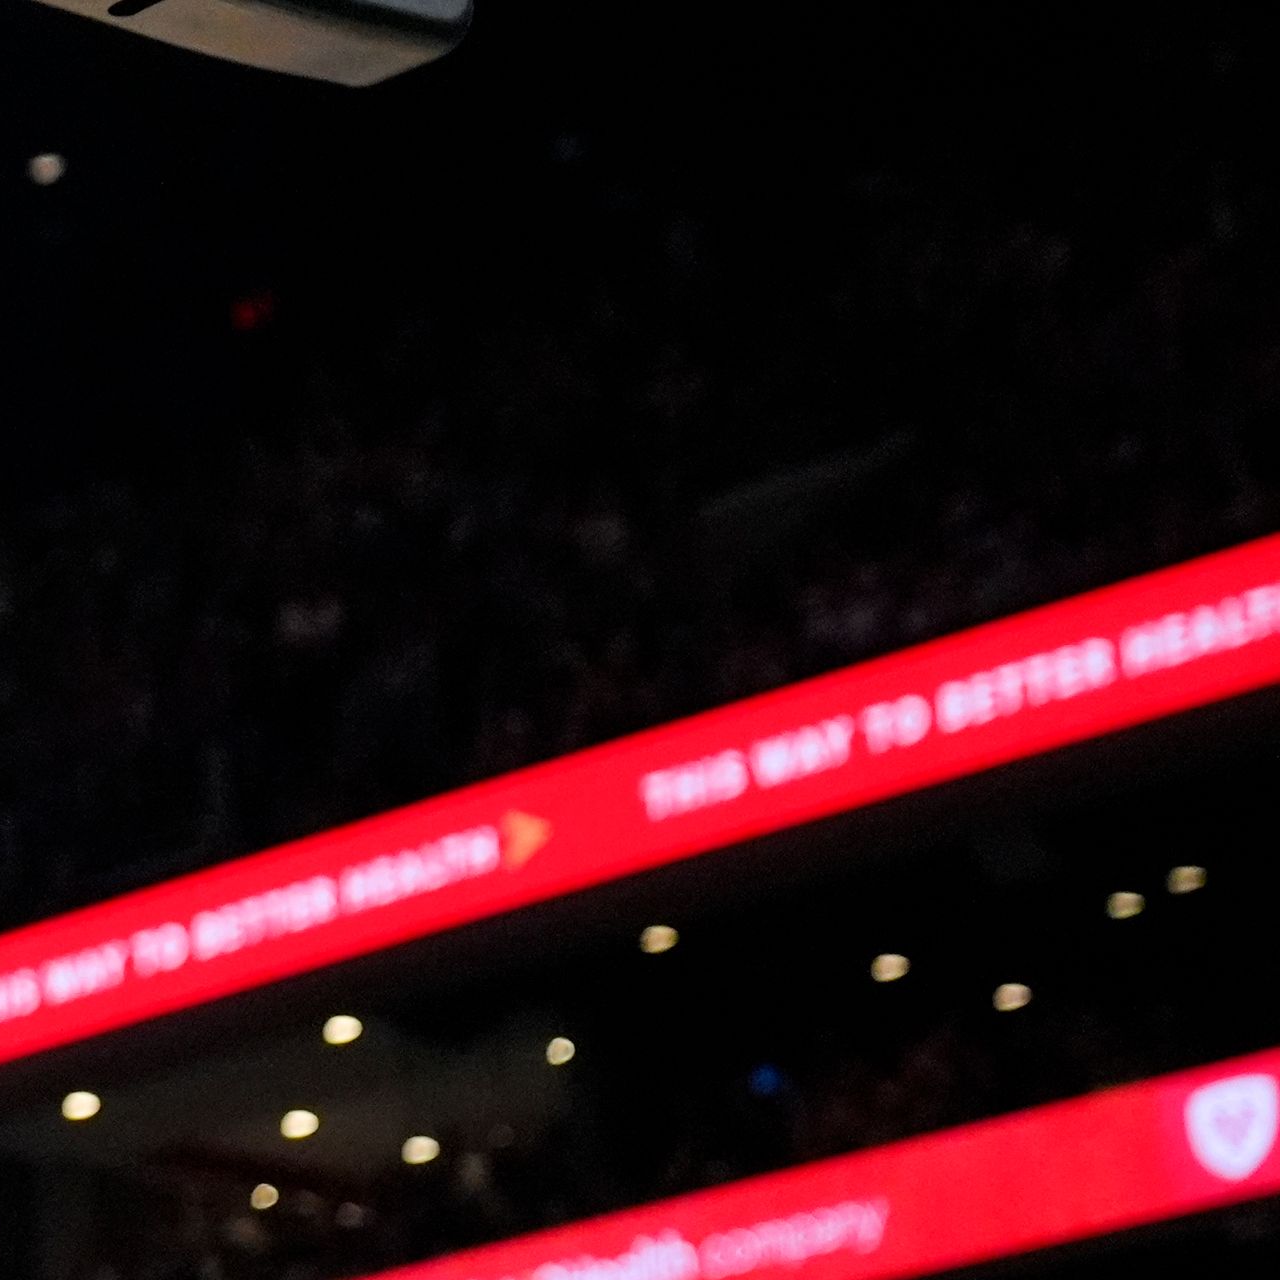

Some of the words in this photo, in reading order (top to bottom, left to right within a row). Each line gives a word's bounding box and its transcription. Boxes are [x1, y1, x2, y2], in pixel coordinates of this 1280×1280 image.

[750, 715, 854, 788] WAY
[862, 695, 931, 754] TO
[935, 637, 1115, 734] BETTER
[132, 921, 189, 978] TO
[190, 875, 338, 961] BETTER
